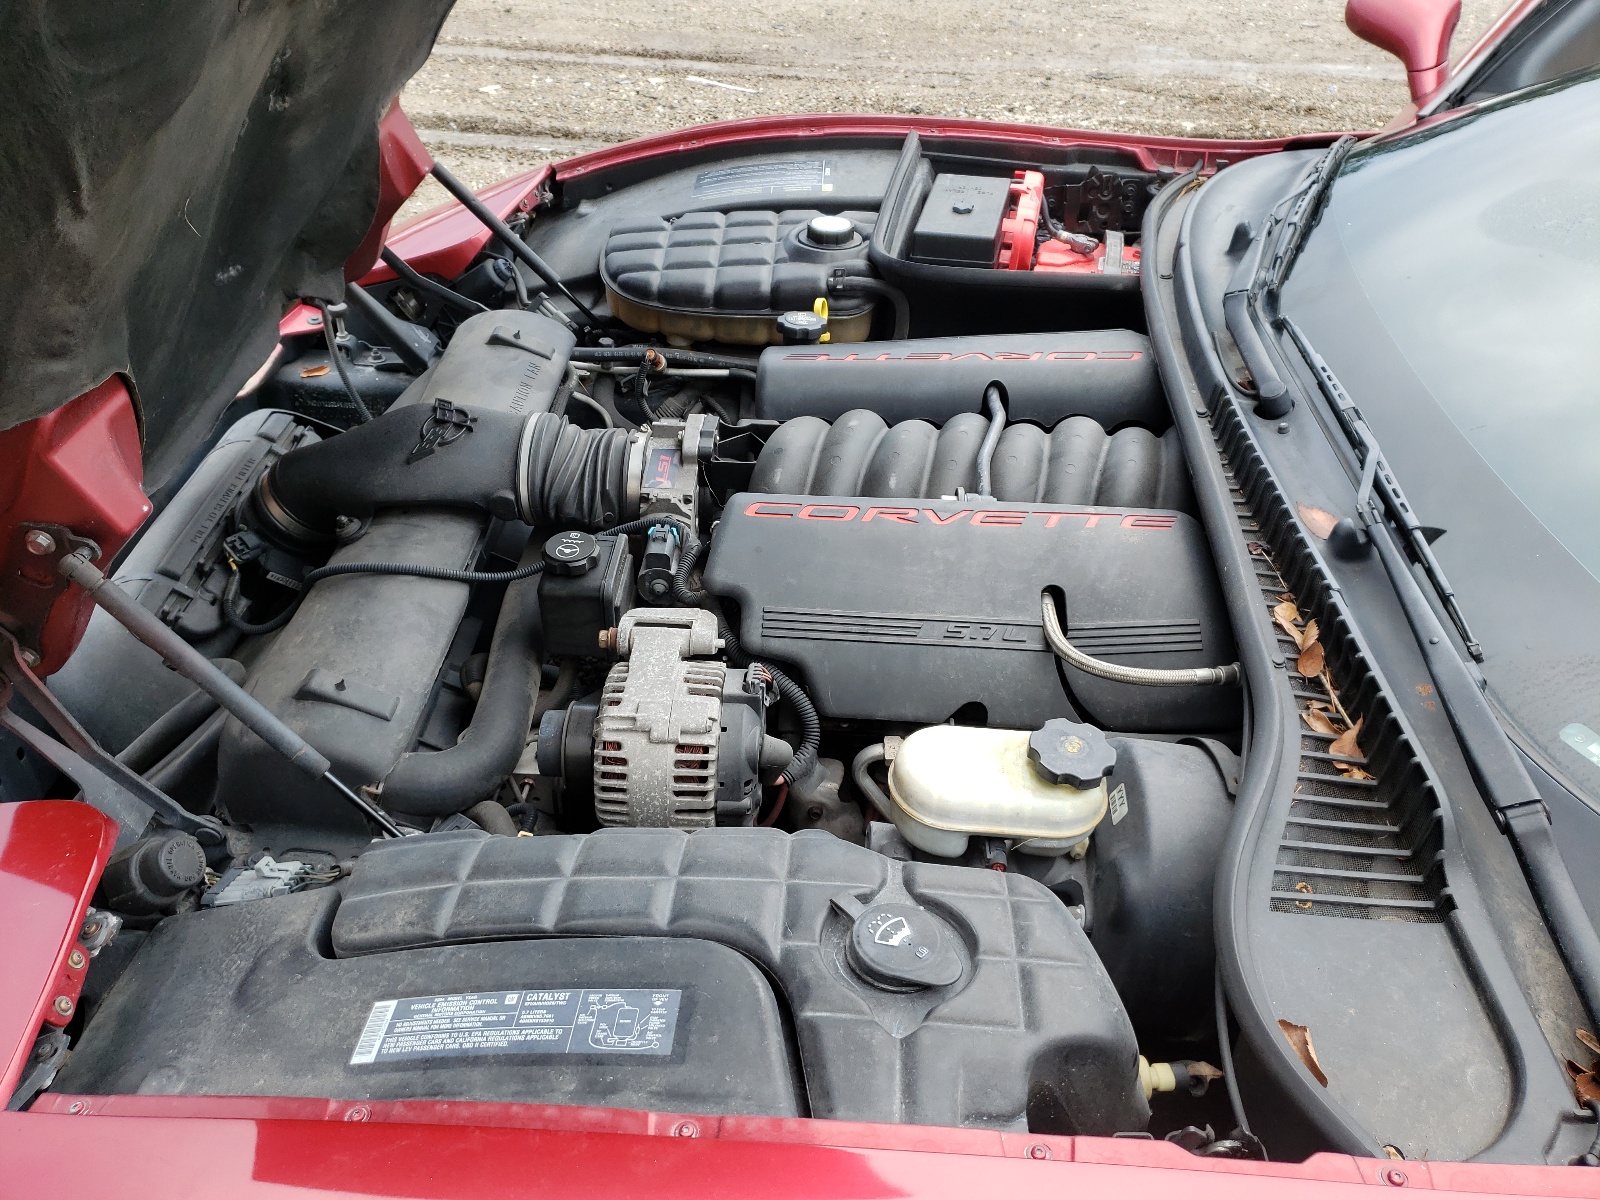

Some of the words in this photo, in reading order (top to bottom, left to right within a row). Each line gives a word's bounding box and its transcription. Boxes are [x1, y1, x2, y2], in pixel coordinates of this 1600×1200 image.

[782, 351, 1144, 362] CORVETTE
[743, 501, 1178, 531] CORVETTE
[942, 622, 1027, 644] 5.7L
[526, 992, 571, 1001] CATALYST
[410, 1002, 436, 1010] VEHICLE
[437, 1000, 468, 1008] EMISSION
[469, 998, 498, 1006] CONTROL
[431, 1005, 475, 1013] INFORMATION
[398, 1034, 420, 1042] VEHICLE
[396, 1039, 427, 1047] PASSENGER
[412, 1044, 444, 1052] PASSENGER
